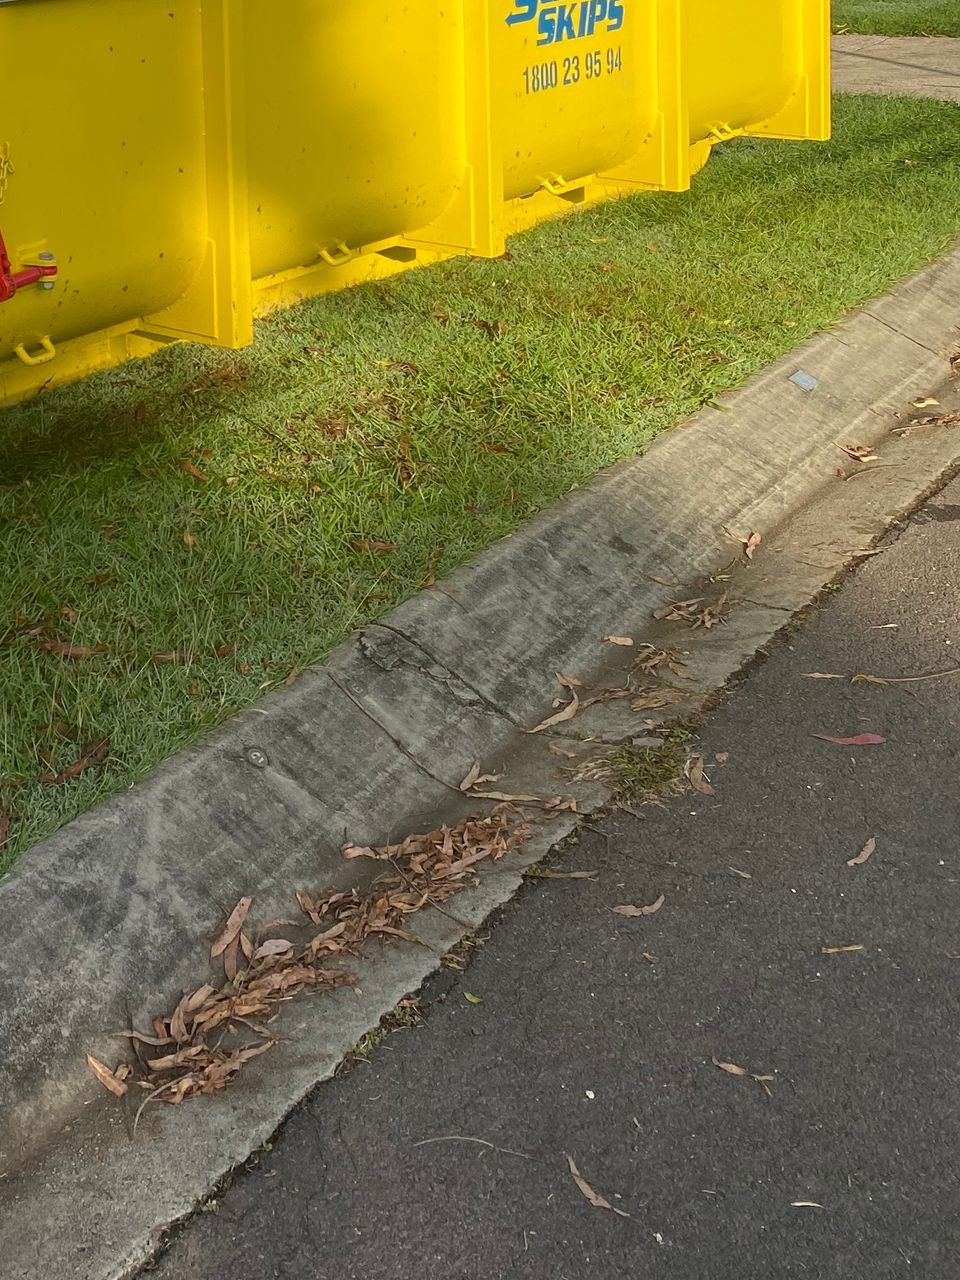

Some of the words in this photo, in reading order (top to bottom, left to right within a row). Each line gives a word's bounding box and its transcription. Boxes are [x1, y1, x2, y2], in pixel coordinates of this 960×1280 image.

[523, 60, 558, 95] 1800
[563, 55, 580, 86] 23
[585, 50, 601, 80] 95
[606, 46, 622, 75] 94
